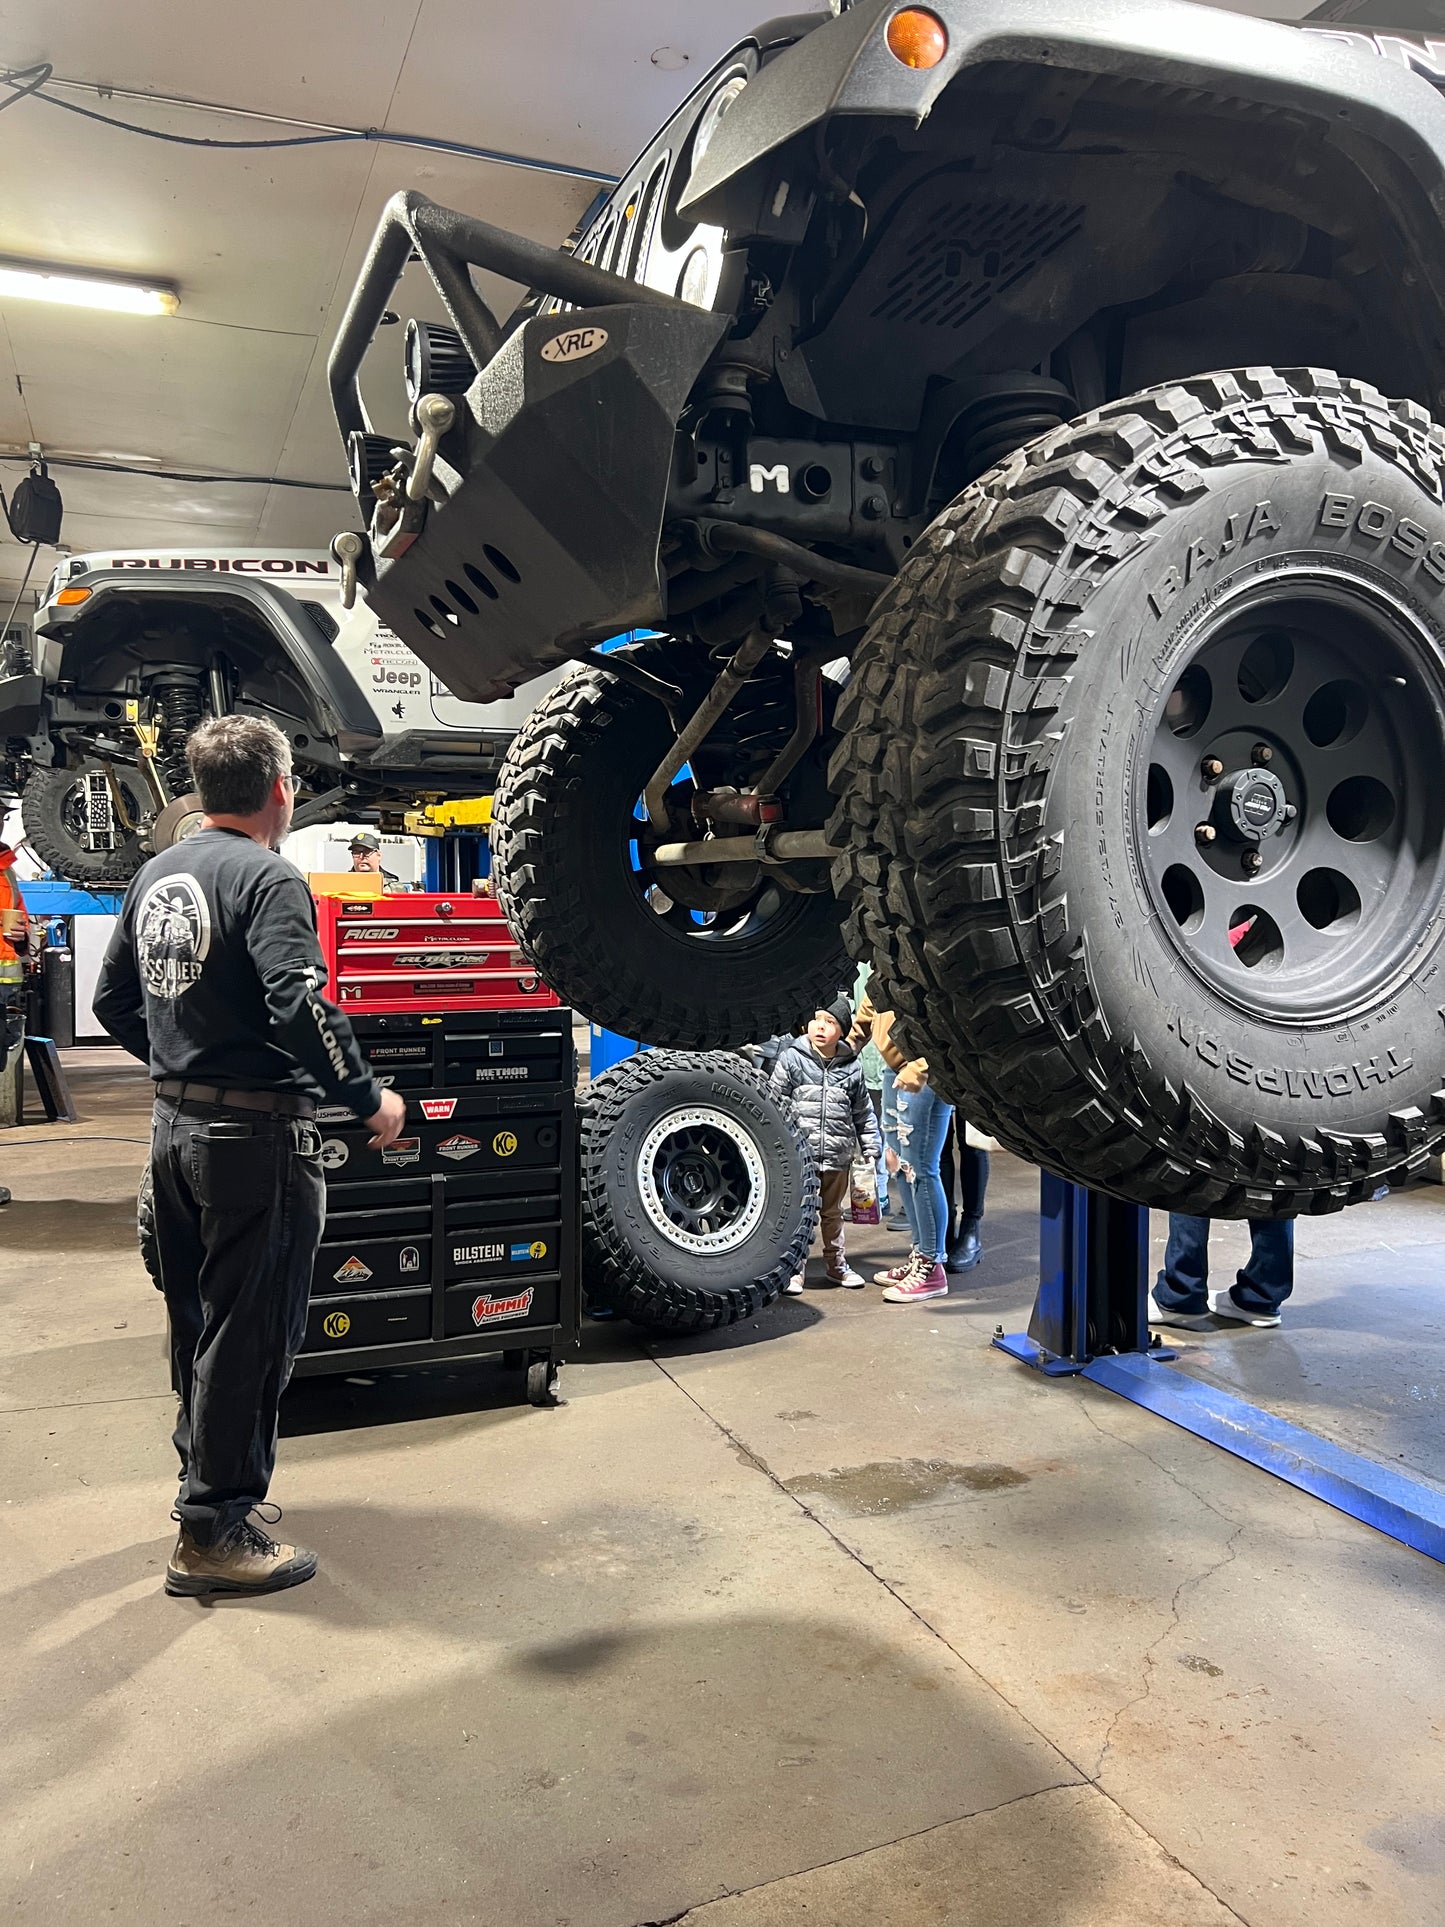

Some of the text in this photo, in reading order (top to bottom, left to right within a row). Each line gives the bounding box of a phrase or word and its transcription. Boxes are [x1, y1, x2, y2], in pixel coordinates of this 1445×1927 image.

[552, 329, 595, 360] XRC
[749, 463, 790, 493] M
[111, 558, 330, 574] RUBICON
[1147, 499, 1282, 622] BAJA
[372, 667, 422, 688] Jeep
[372, 687, 422, 695] WRANGLER
[343, 928, 400, 940] RIGID
[1166, 1016, 1414, 1099] THOMPSON
[475, 1066, 529, 1077] METHOD
[425, 1104, 451, 1114] WARN
[710, 1081, 773, 1127] MICKEY
[495, 1132, 516, 1155] KC
[768, 1136, 793, 1246] THOMPSON
[453, 1243, 505, 1261] BILSTEIN
[474, 1291, 531, 1322] SUMMIT
[326, 1312, 349, 1337] KC
